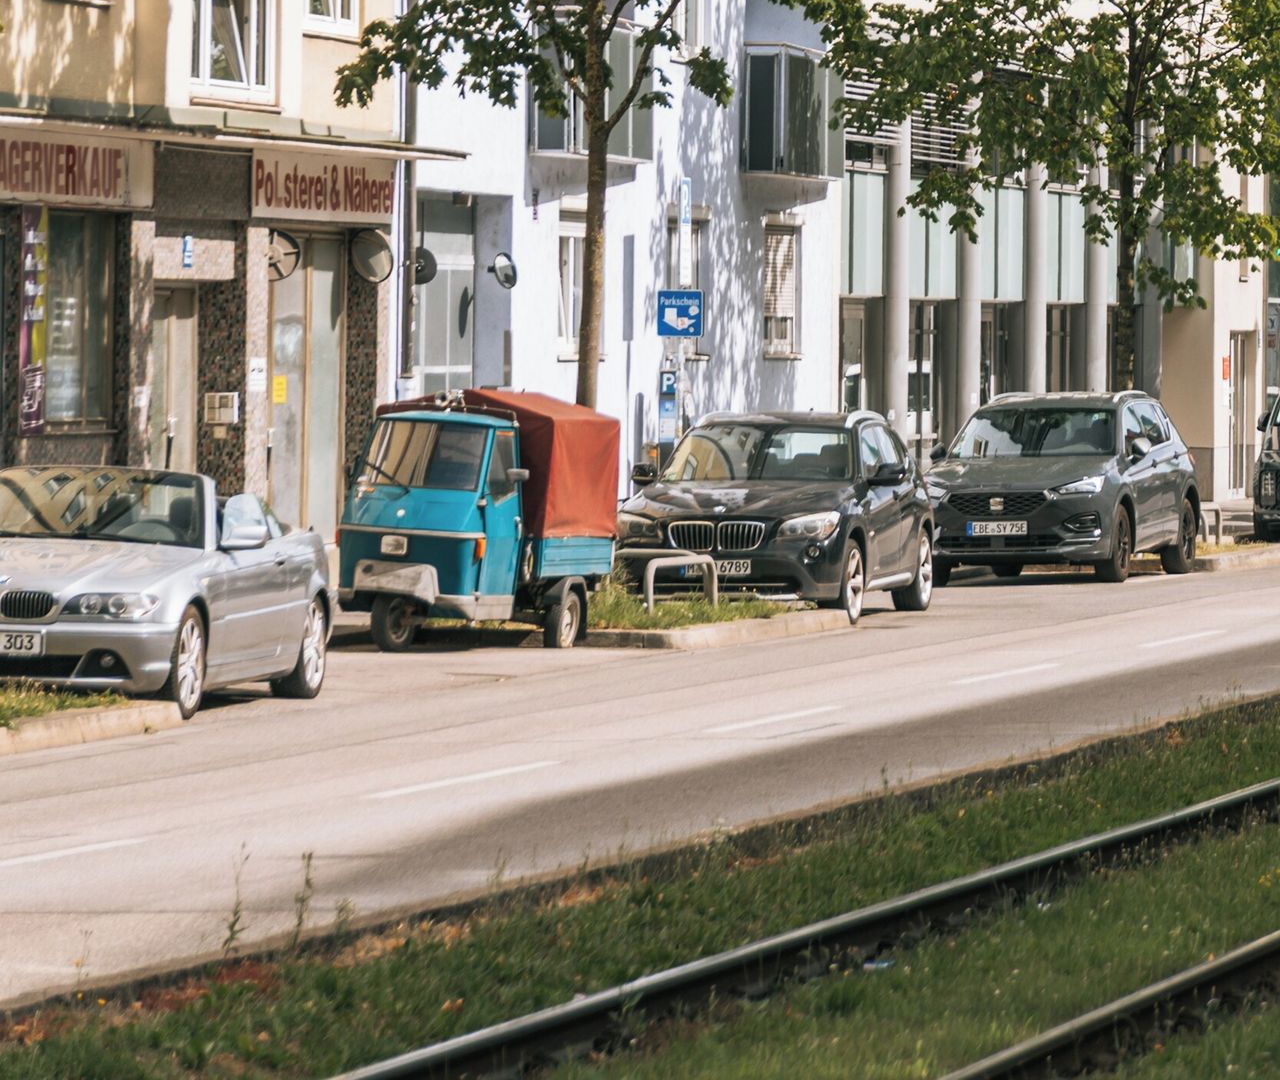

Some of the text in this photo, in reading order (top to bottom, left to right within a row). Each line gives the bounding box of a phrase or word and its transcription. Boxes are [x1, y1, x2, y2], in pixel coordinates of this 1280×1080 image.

[329, 164, 341, 212] &
[343, 166, 394, 215] Näherei
[660, 296, 699, 307] Parkschein
[662, 373, 675, 392] P
[973, 522, 1026, 534] EBE SY 75E
[3, 634, 35, 650] 303
